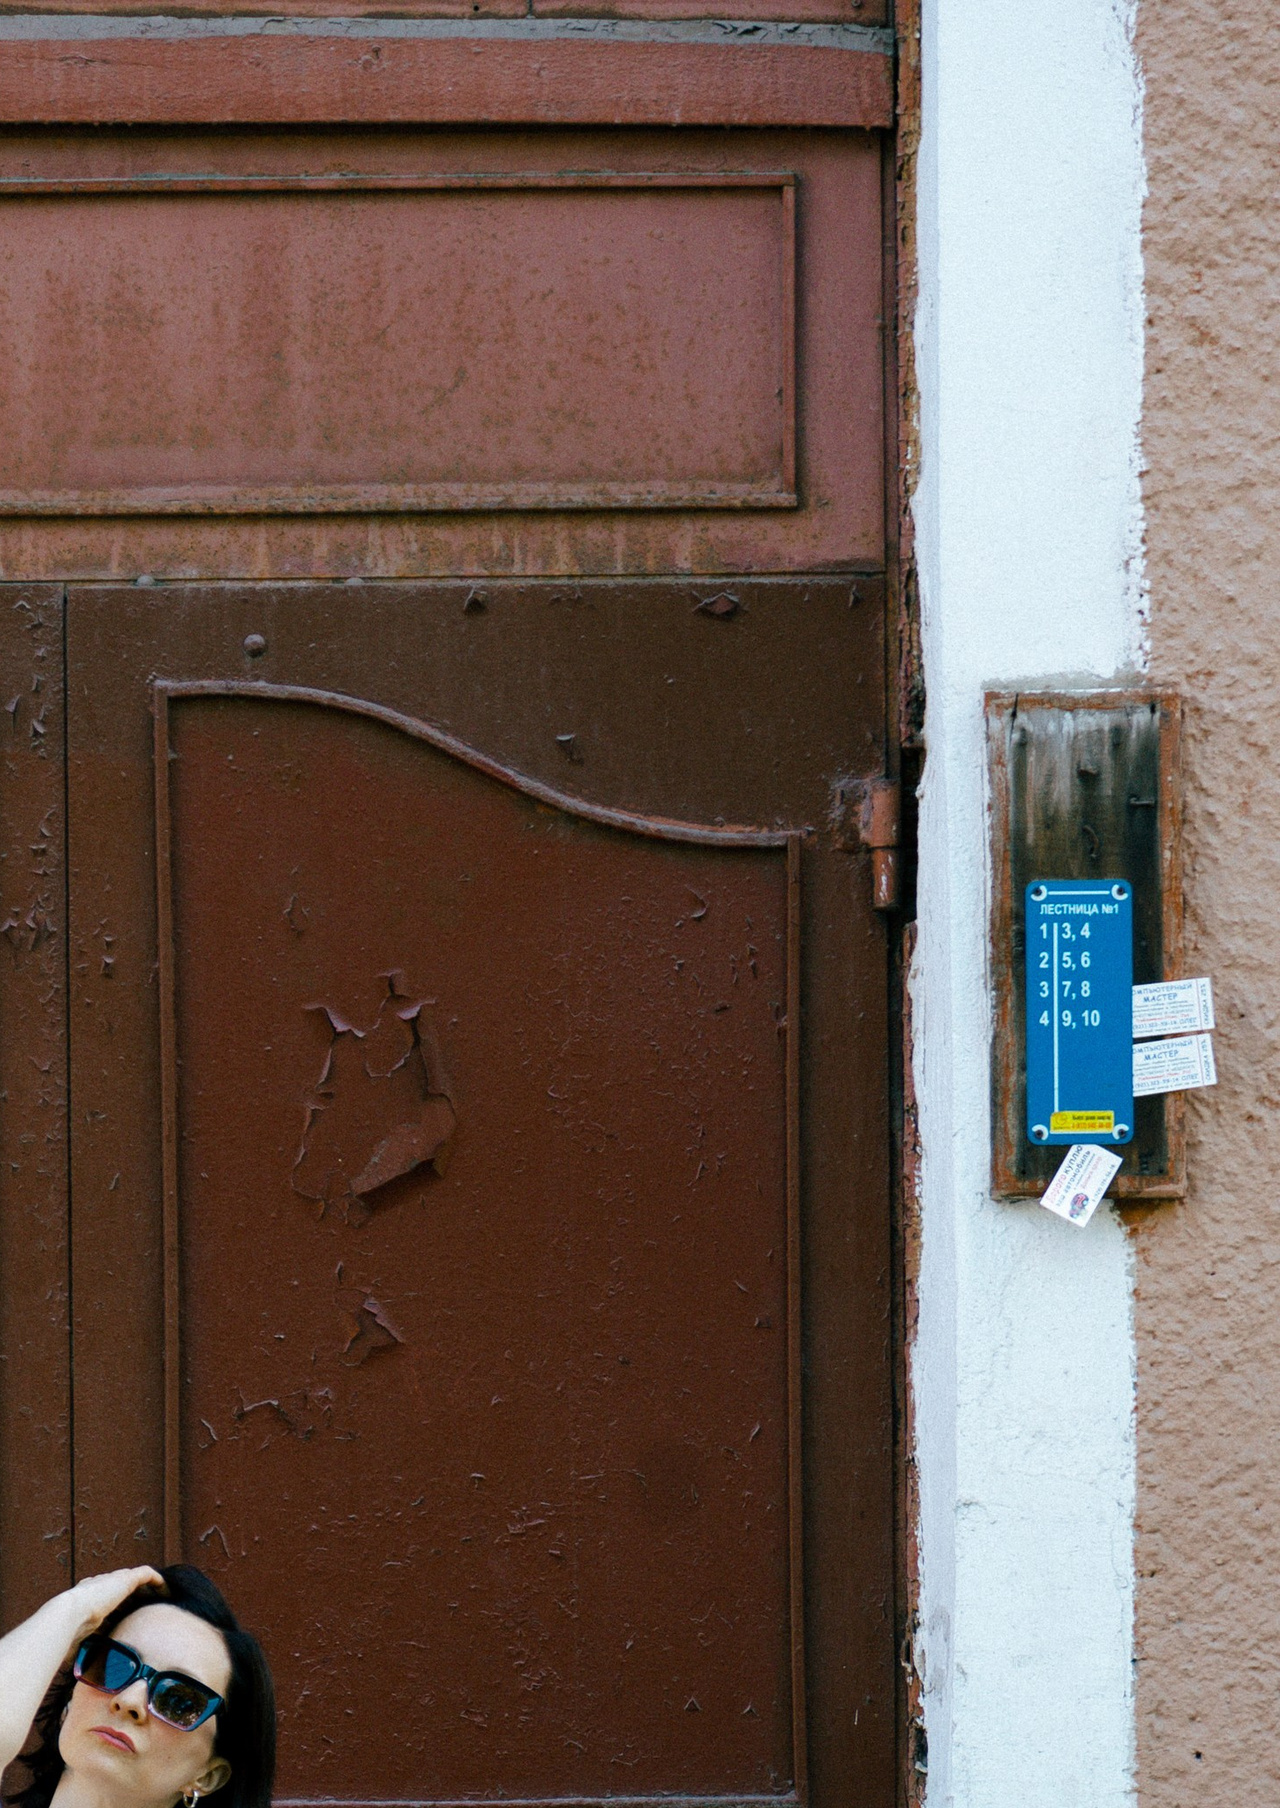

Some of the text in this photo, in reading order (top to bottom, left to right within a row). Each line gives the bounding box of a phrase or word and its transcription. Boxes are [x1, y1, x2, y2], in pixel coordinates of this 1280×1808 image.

[1040, 904, 1118, 916] ЛЕСТНИЦА №1
[1039, 923, 1049, 939] 1
[1080, 923, 1091, 939] 4
[1039, 952, 1049, 968] 2
[1080, 952, 1091, 968] 6
[1039, 981, 1049, 997] 3
[1080, 981, 1091, 997] 8
[1132, 983, 1193, 995] ОМПЬЮТЕРНЫЙ
[1143, 992, 1178, 1002] МАСТЕР
[1039, 1010, 1049, 1026] 4
[1082, 1010, 1100, 1026] 10
[1133, 1039, 1193, 1054] ОМПЬЮТЕРНЫЙ
[1144, 1049, 1179, 1061] МАСТЕР
[1064, 1145, 1083, 1175] куплю
[1063, 1150, 1091, 1193] автомобиль
